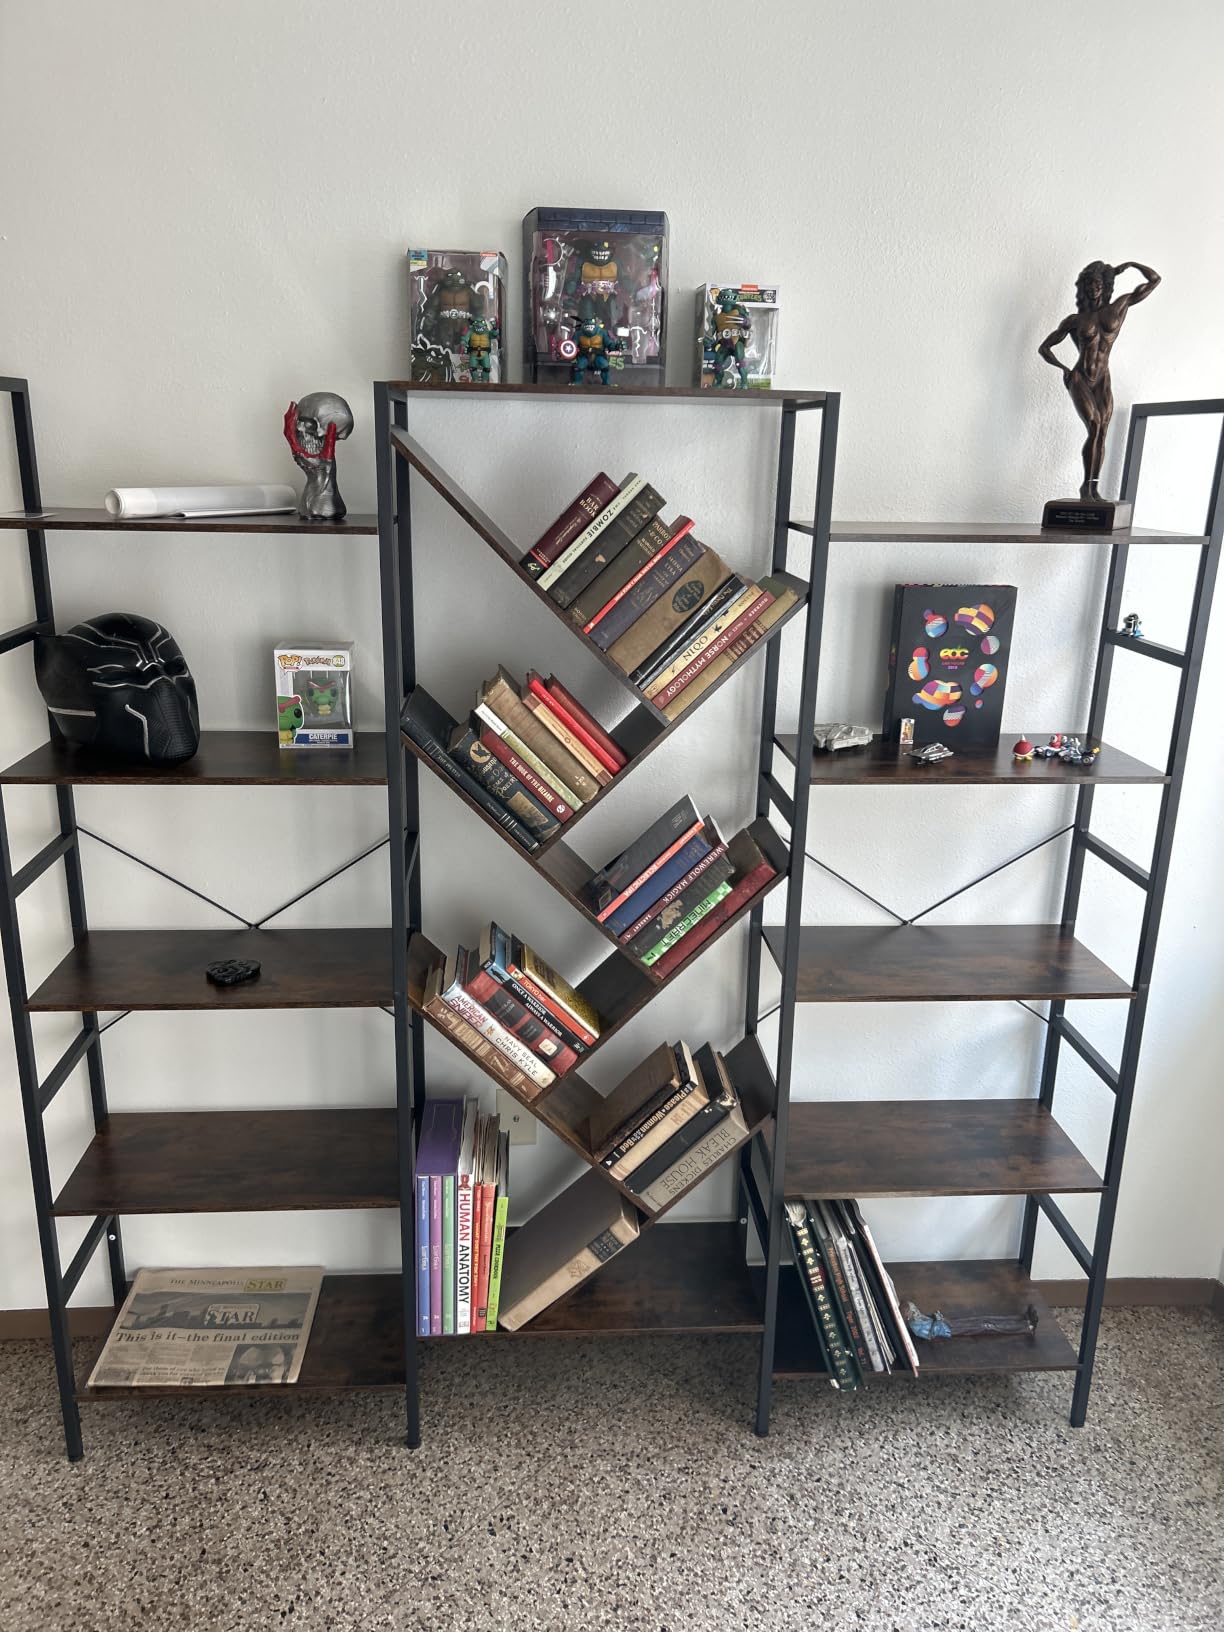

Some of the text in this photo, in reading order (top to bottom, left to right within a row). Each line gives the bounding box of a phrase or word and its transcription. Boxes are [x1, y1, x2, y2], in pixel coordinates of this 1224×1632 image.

[578, 499, 597, 518] BOOK
[585, 496, 599, 511] BAR
[585, 508, 614, 538] ZOMBIE
[703, 634, 729, 659] NORSE
[664, 655, 706, 697] MYTHOLOGY
[508, 756, 554, 802] THE BOOK OF THE BIZARRE
[687, 845, 724, 881] WEREWOLF
[661, 879, 688, 904] MAGICK
[660, 898, 711, 946] MINECRAFT
[510, 982, 523, 995] ONCE
[525, 996, 547, 1014] WARRIOR
[522, 980, 539, 996] TOKYO
[447, 997, 483, 1029] SNIPER
[454, 993, 488, 1023] AMERICAN
[524, 1001, 541, 1017] ALWAYS
[542, 1017, 563, 1036] WARRIOR
[494, 1036, 538, 1076] CHRIS KYLE
[503, 1035, 538, 1068] NAVY SEAL
[662, 1089, 686, 1111] Please
[638, 1109, 665, 1134] Woman
[618, 1138, 634, 1152] Bed
[659, 1127, 729, 1189] BLEAK HOUSE
[667, 1136, 737, 1195] CHARLES DICKENS
[458, 1193, 471, 1304] HUMAN ANATOMY
[247, 1280, 284, 1289] STAR
[206, 1310, 255, 1323] STAR
[116, 1332, 147, 1342] This
[150, 1332, 162, 1341] is
[213, 1332, 246, 1342] final
[251, 1332, 299, 1341] edition
